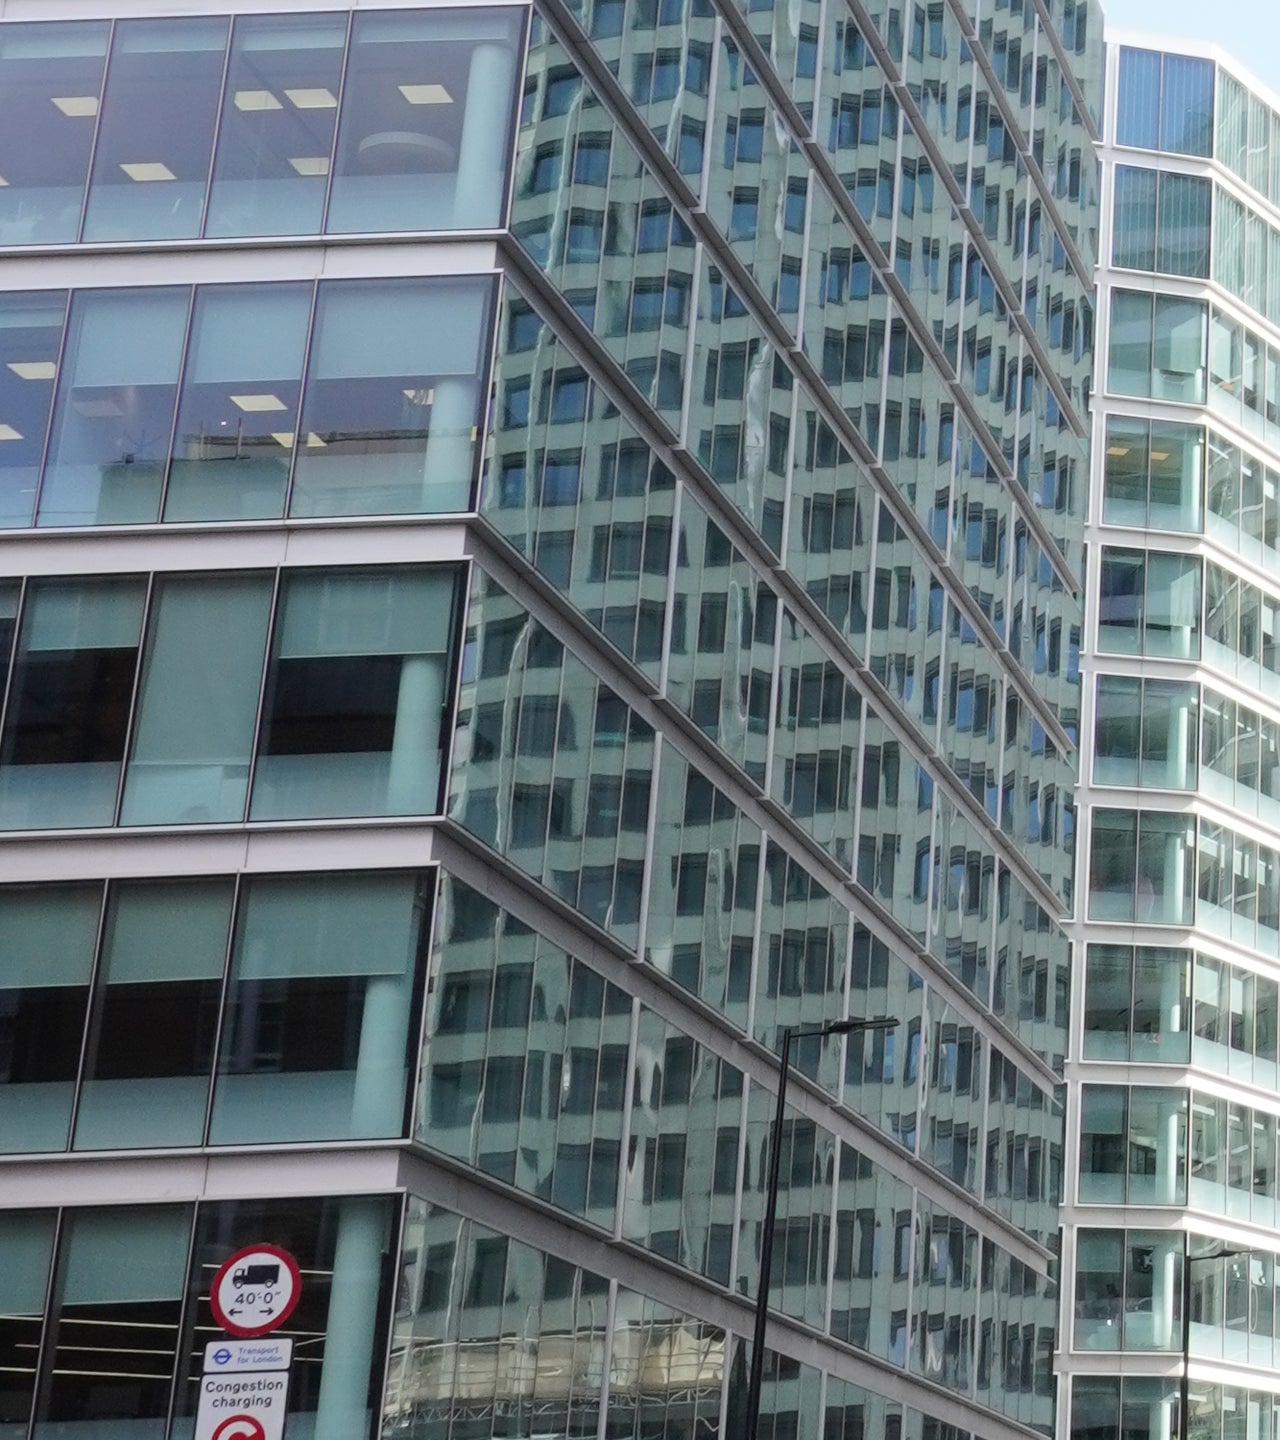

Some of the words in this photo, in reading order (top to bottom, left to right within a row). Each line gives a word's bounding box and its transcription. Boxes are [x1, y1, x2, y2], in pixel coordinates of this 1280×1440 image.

[239, 1346, 279, 1355] Transport
[252, 1356, 283, 1364] London
[205, 1380, 283, 1394] Congestion
[212, 1395, 272, 1409] charging
